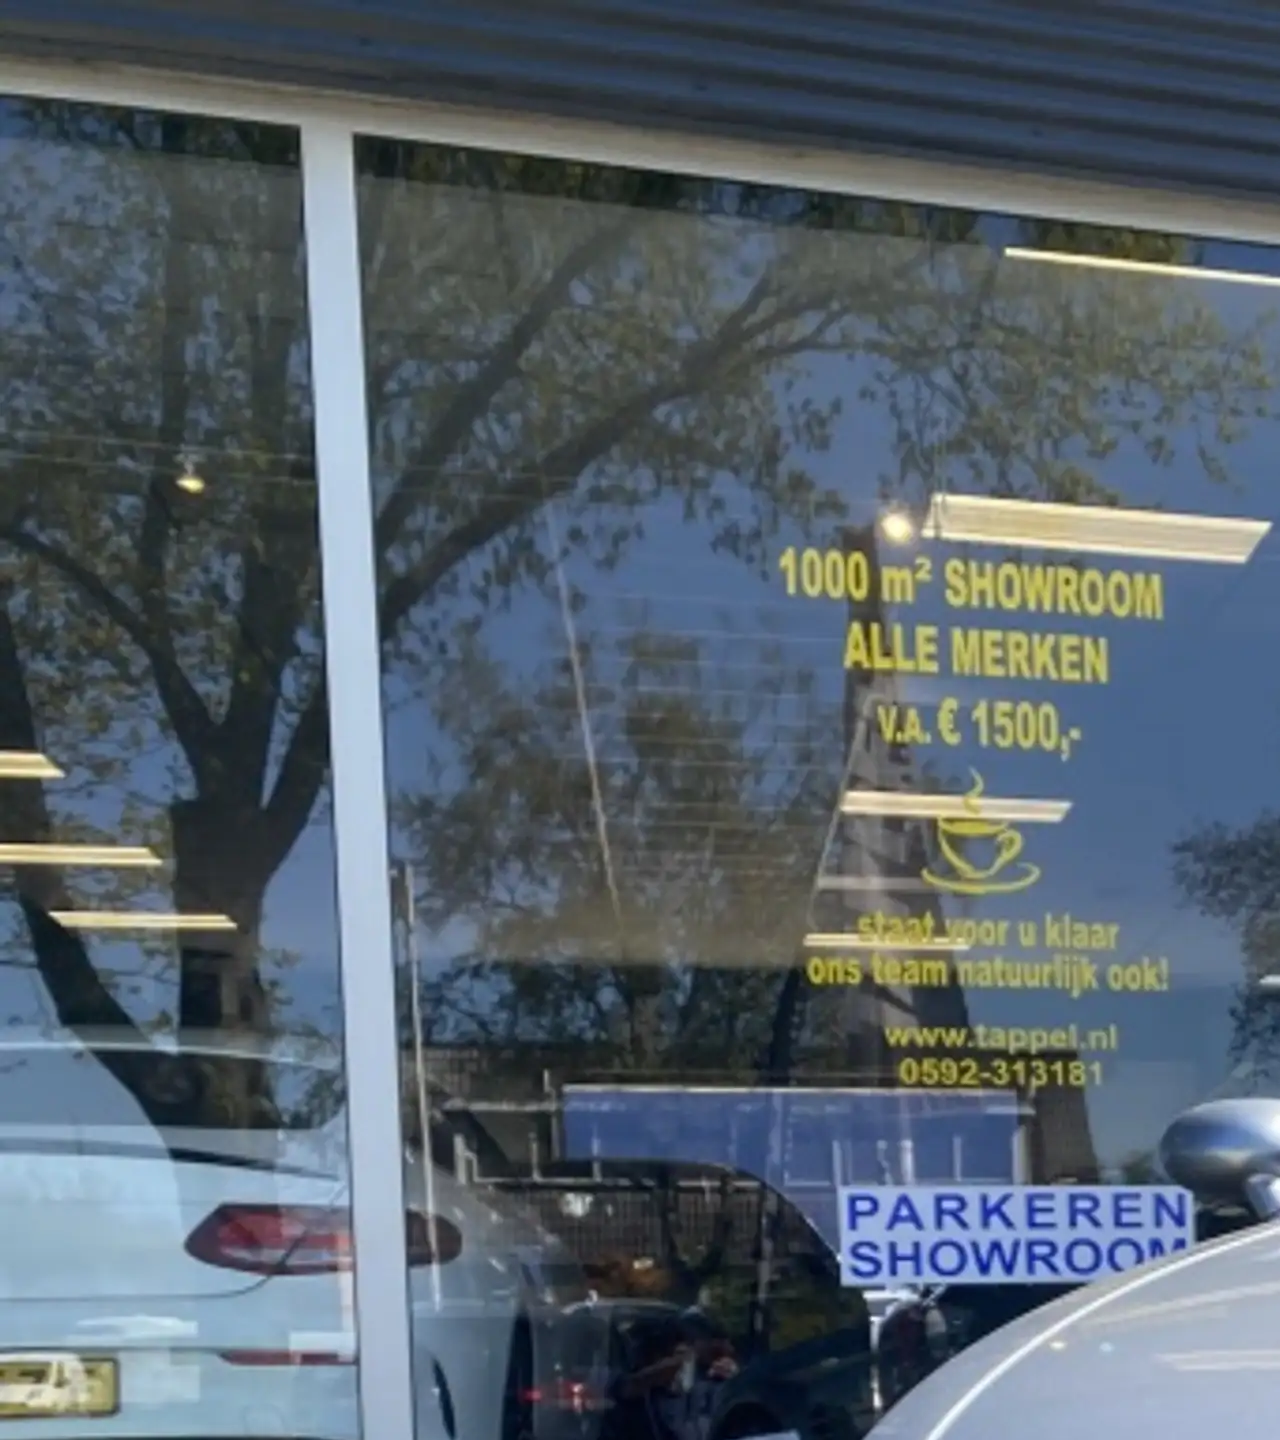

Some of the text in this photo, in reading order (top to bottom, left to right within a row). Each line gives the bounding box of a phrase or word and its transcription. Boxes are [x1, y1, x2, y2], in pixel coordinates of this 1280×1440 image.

[779, 546, 1163, 619] 1000 m² SHOWROOM
[844, 620, 1108, 683] ALLE MERKEN
[971, 699, 1082, 761] 1500,-
[858, 911, 1120, 949] staat voor u klaar
[807, 953, 1169, 998] ons team natuurlijk ook!
[885, 1024, 1118, 1054] www.tappel.nl
[901, 1058, 1102, 1086] 0592-313181
[847, 1191, 1187, 1231] PARKEREN
